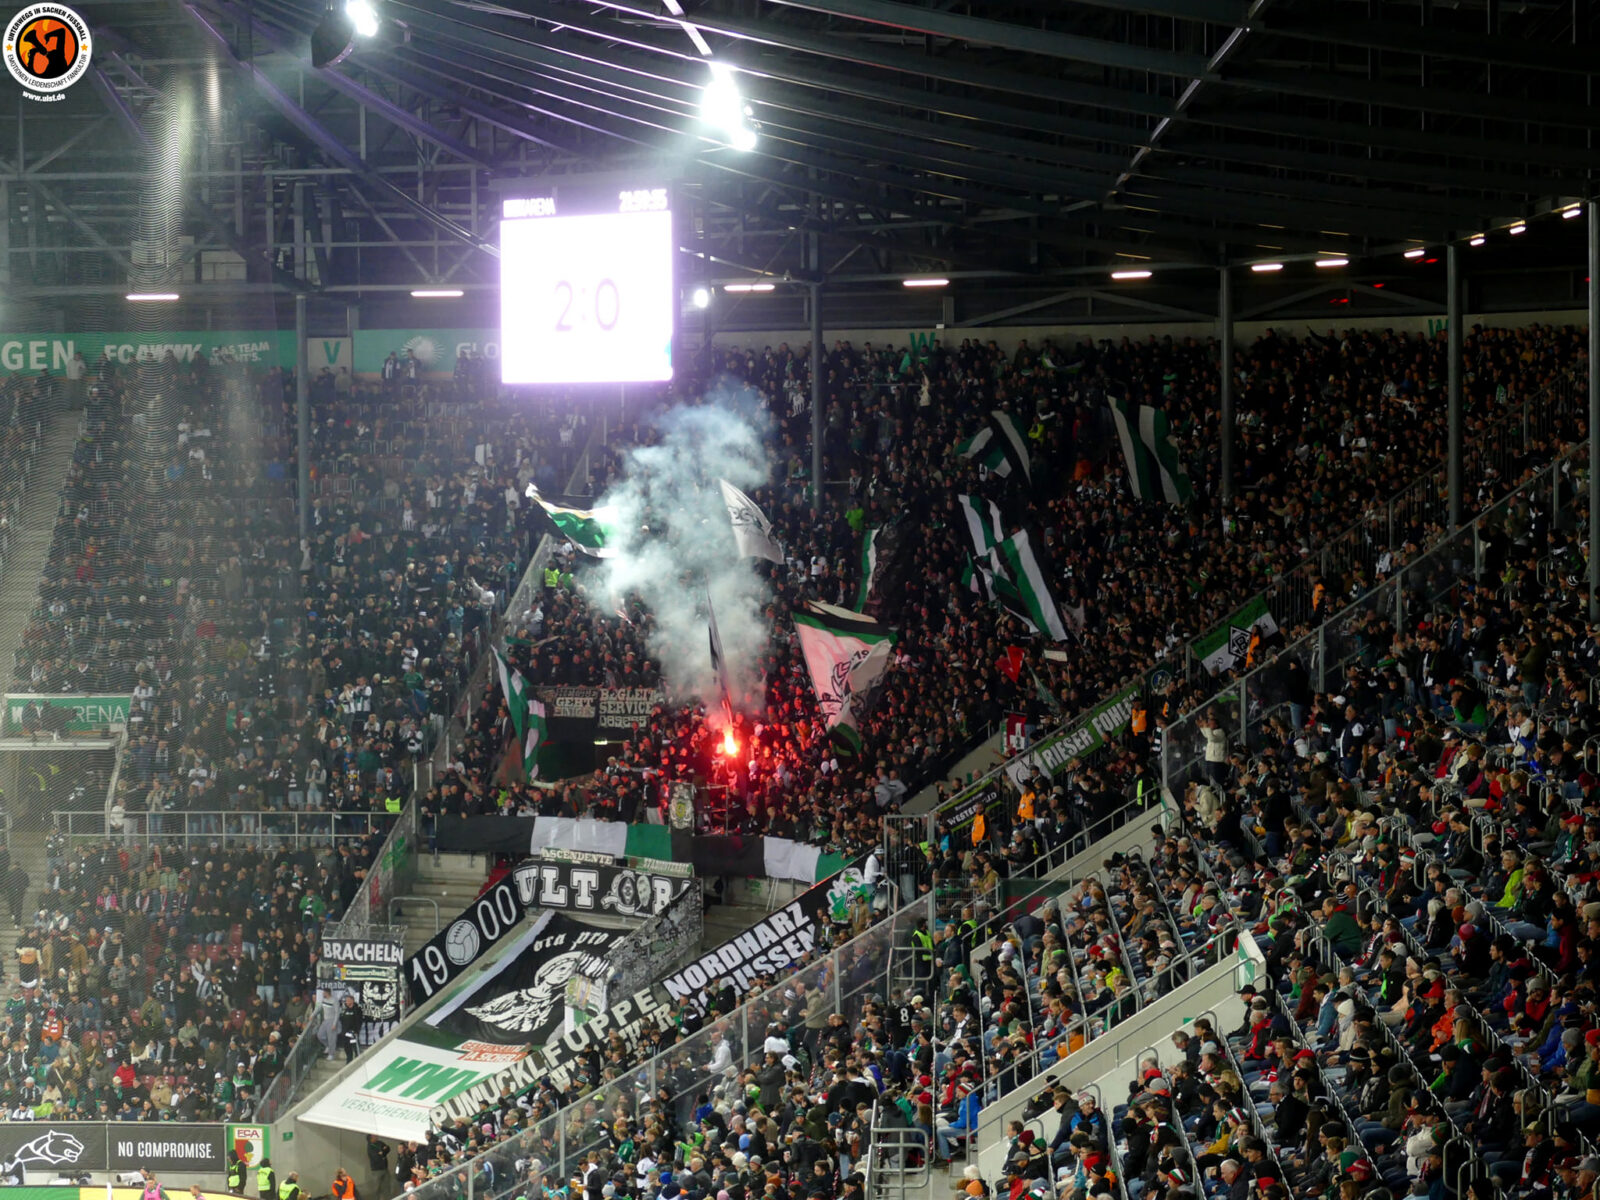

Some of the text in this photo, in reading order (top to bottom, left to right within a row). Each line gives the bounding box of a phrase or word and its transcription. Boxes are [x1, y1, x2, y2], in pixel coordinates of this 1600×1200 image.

[1, 340, 75, 370] GEN
[238, 341, 270, 353] TEAM
[323, 341, 341, 364] V
[599, 701, 654, 715] SERVICE
[1042, 727, 1095, 769] RIESER
[947, 792, 997, 826] WESTELD
[541, 848, 613, 865] ASCENDENTE
[533, 931, 567, 953] ora
[571, 929, 609, 952] pro
[663, 901, 810, 1001] NORDHARZ
[900, 1008, 909, 1022] 8
[431, 1055, 547, 1128] PUMUCKL
[542, 987, 658, 1068] FUPPE
[237, 1129, 260, 1138] FCA
[118, 1141, 216, 1159] NO COMPROMISE.
